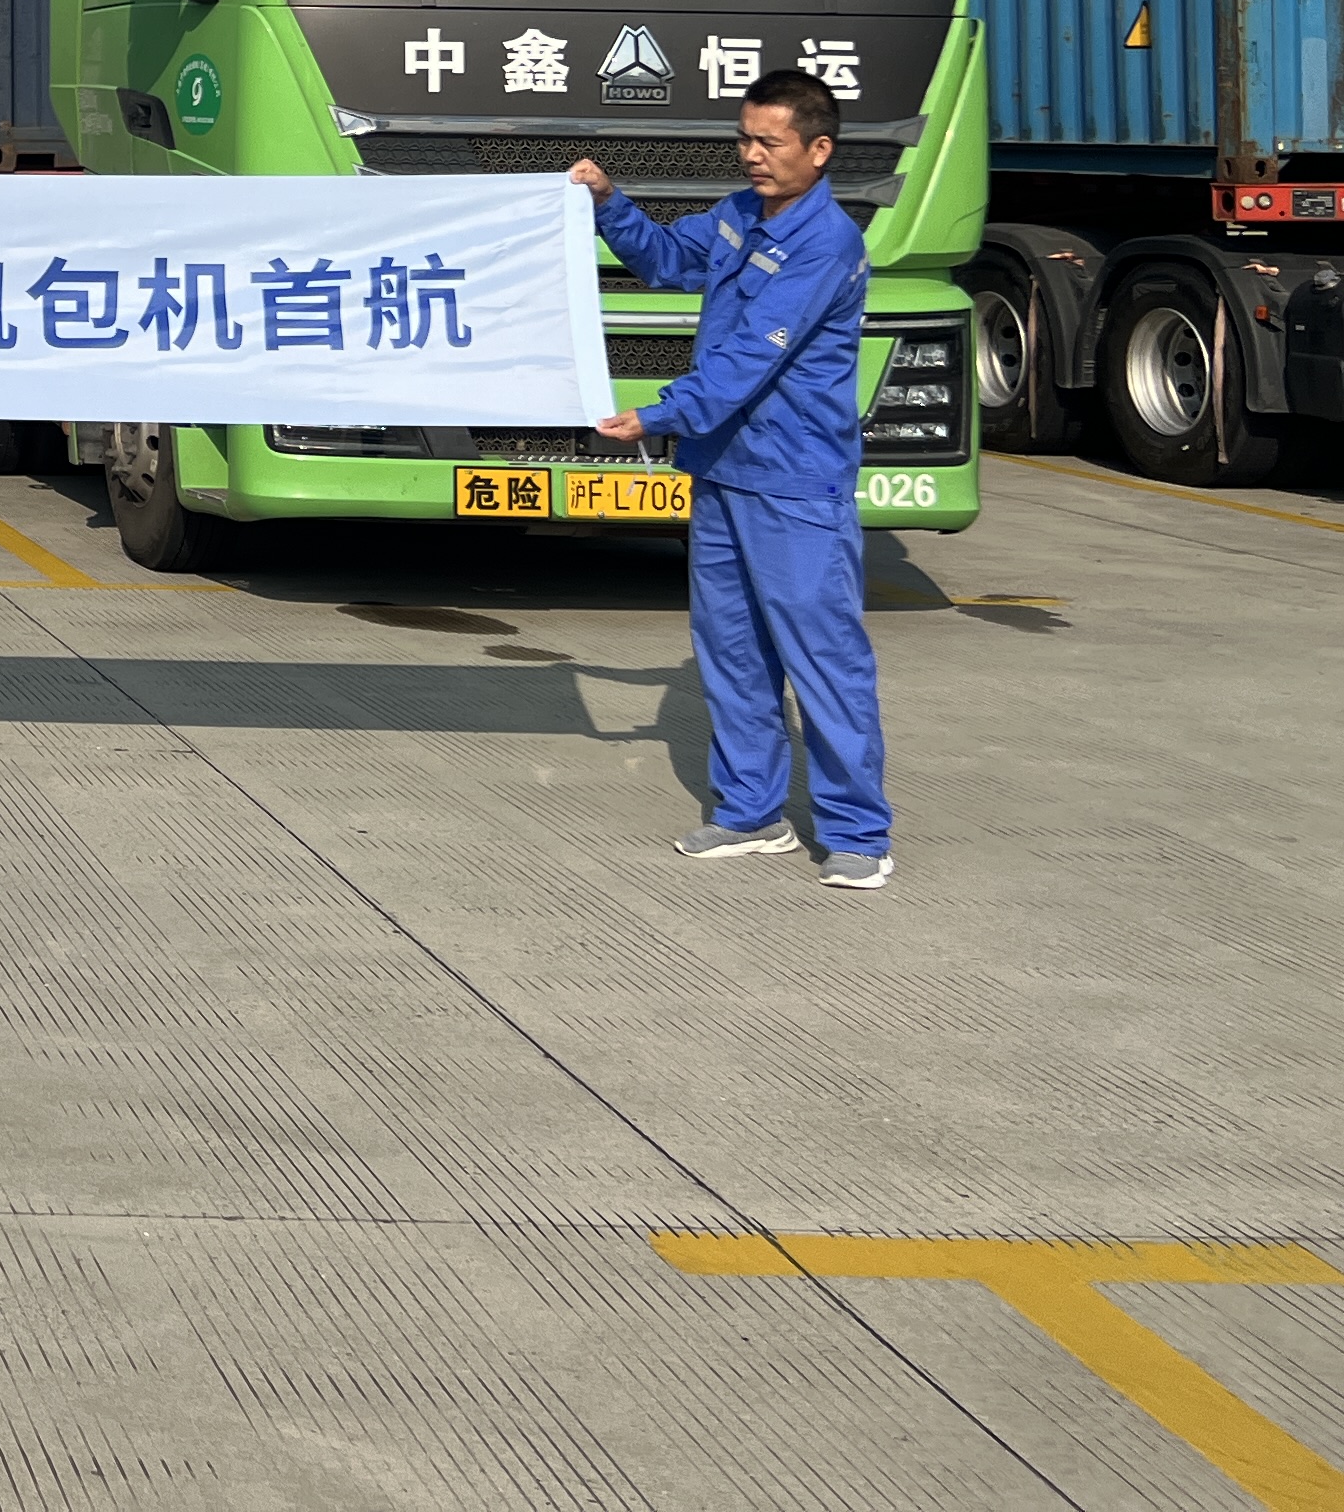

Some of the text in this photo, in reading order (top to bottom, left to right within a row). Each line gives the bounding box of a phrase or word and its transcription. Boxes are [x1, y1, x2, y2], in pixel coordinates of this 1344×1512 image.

[404, 27, 861, 100] 中鑫 恒运
[608, 87, 666, 100] HOWO
[464, 475, 542, 511] 危险
